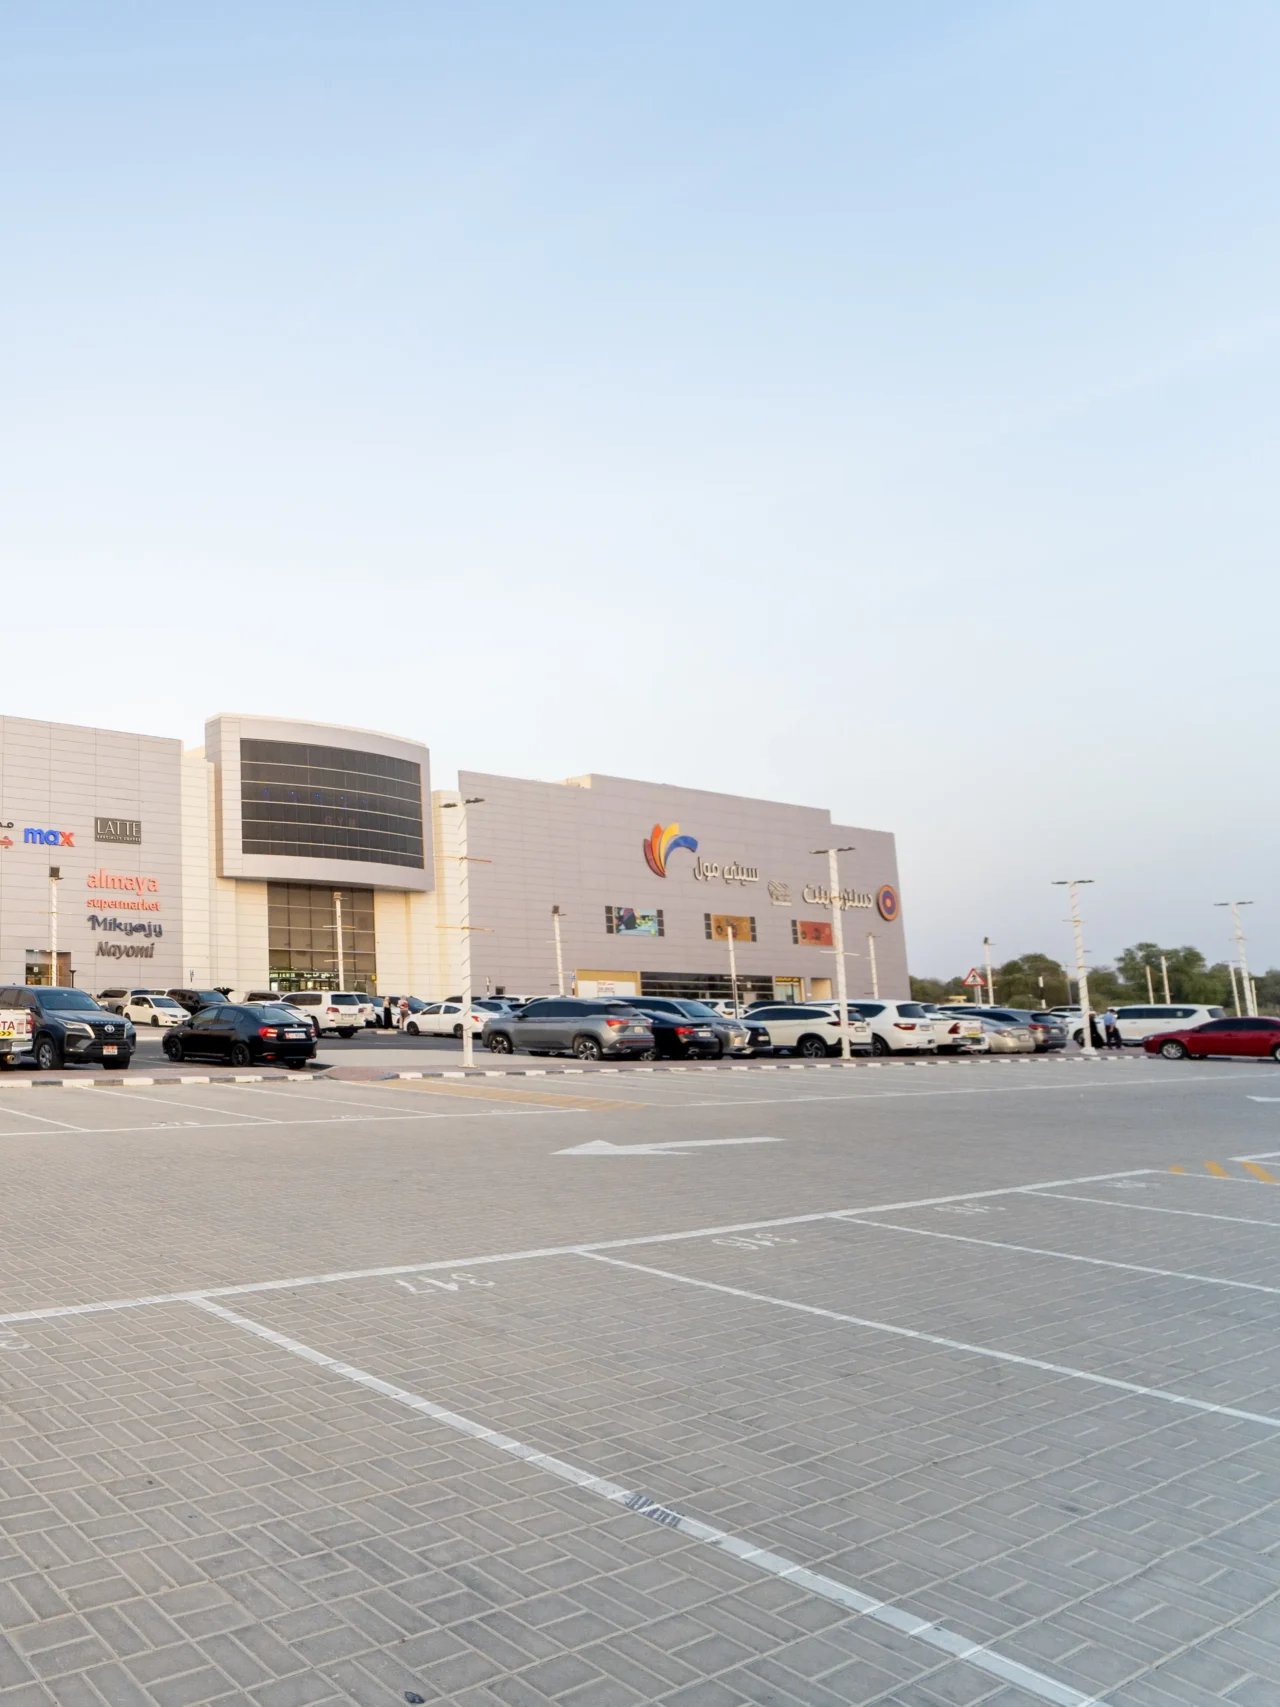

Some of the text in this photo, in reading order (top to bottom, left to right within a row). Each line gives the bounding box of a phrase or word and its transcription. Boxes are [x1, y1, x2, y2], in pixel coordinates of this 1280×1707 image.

[97, 819, 141, 837] LATTE
[324, 815, 357, 828] GYM
[23, 827, 75, 847] max
[693, 856, 760, 887] سيتي مول
[87, 868, 159, 896] almaya
[86, 898, 161, 911] supermarket
[86, 914, 163, 938] Mikyajy
[95, 940, 155, 960] Nayomi
[394, 1272, 495, 1294] 317
